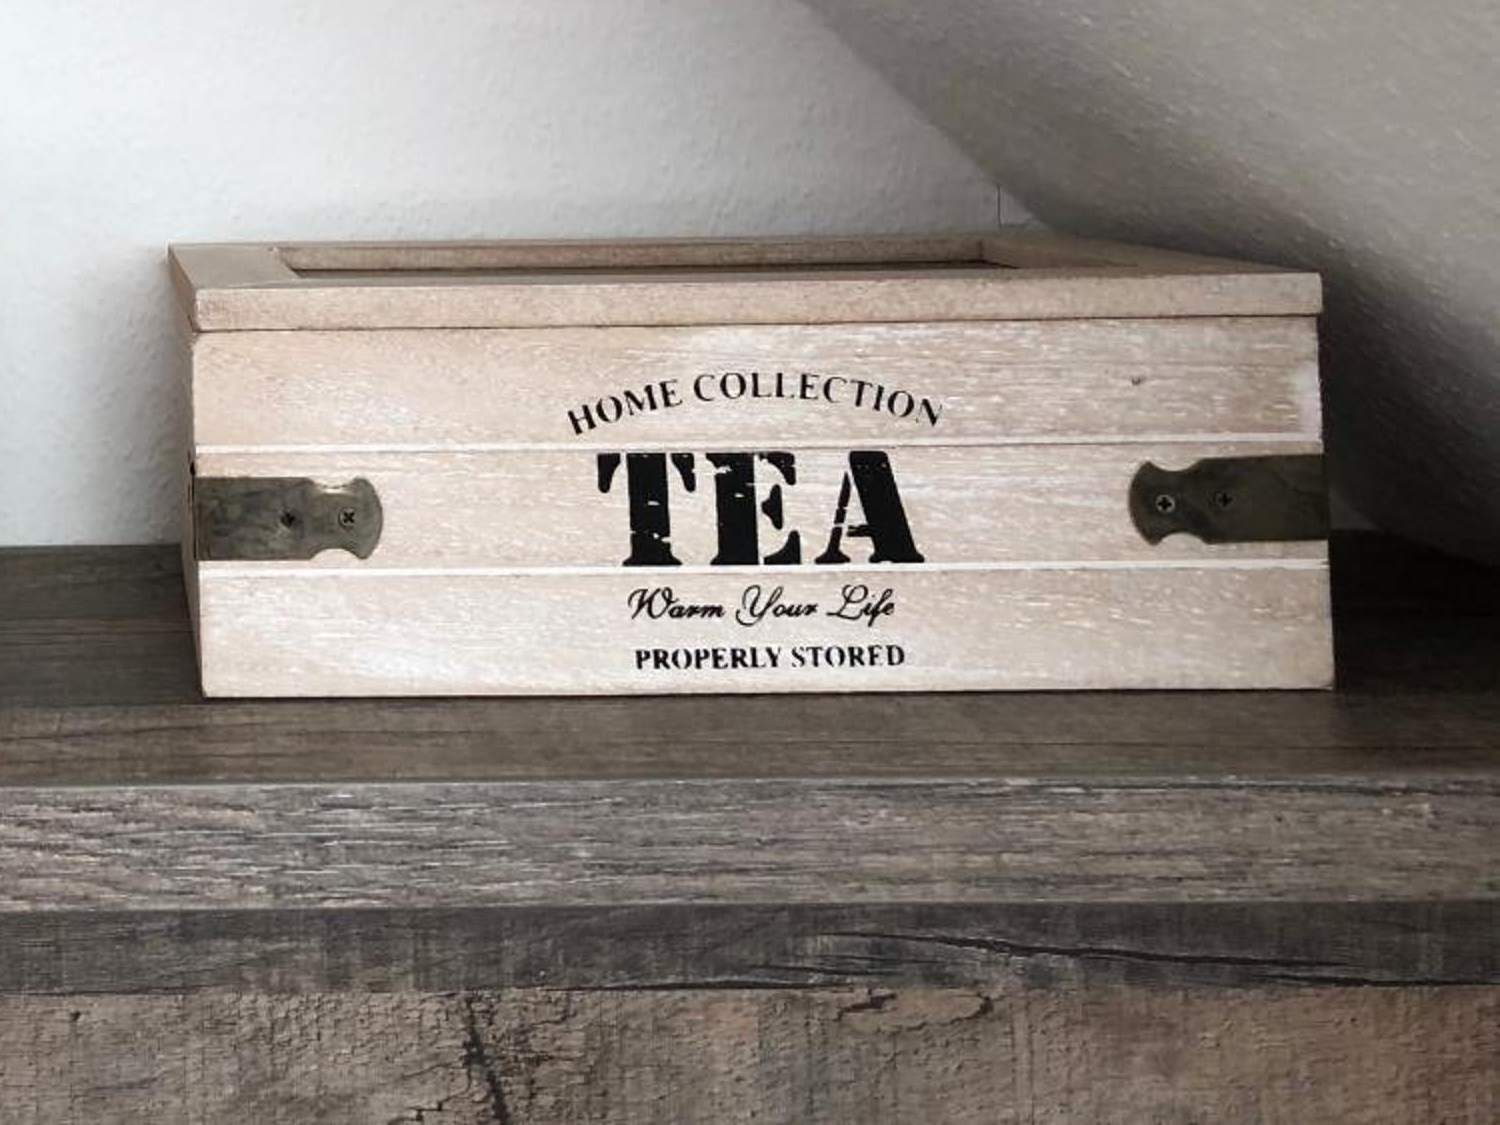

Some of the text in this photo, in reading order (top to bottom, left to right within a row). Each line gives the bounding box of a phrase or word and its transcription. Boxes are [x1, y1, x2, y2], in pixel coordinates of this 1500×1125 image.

[567, 372, 943, 435] HOME COLLECTION
[597, 450, 925, 566] TEA
[627, 583, 896, 628] Warm Your Life
[634, 644, 906, 671] PROPERLY STORED
